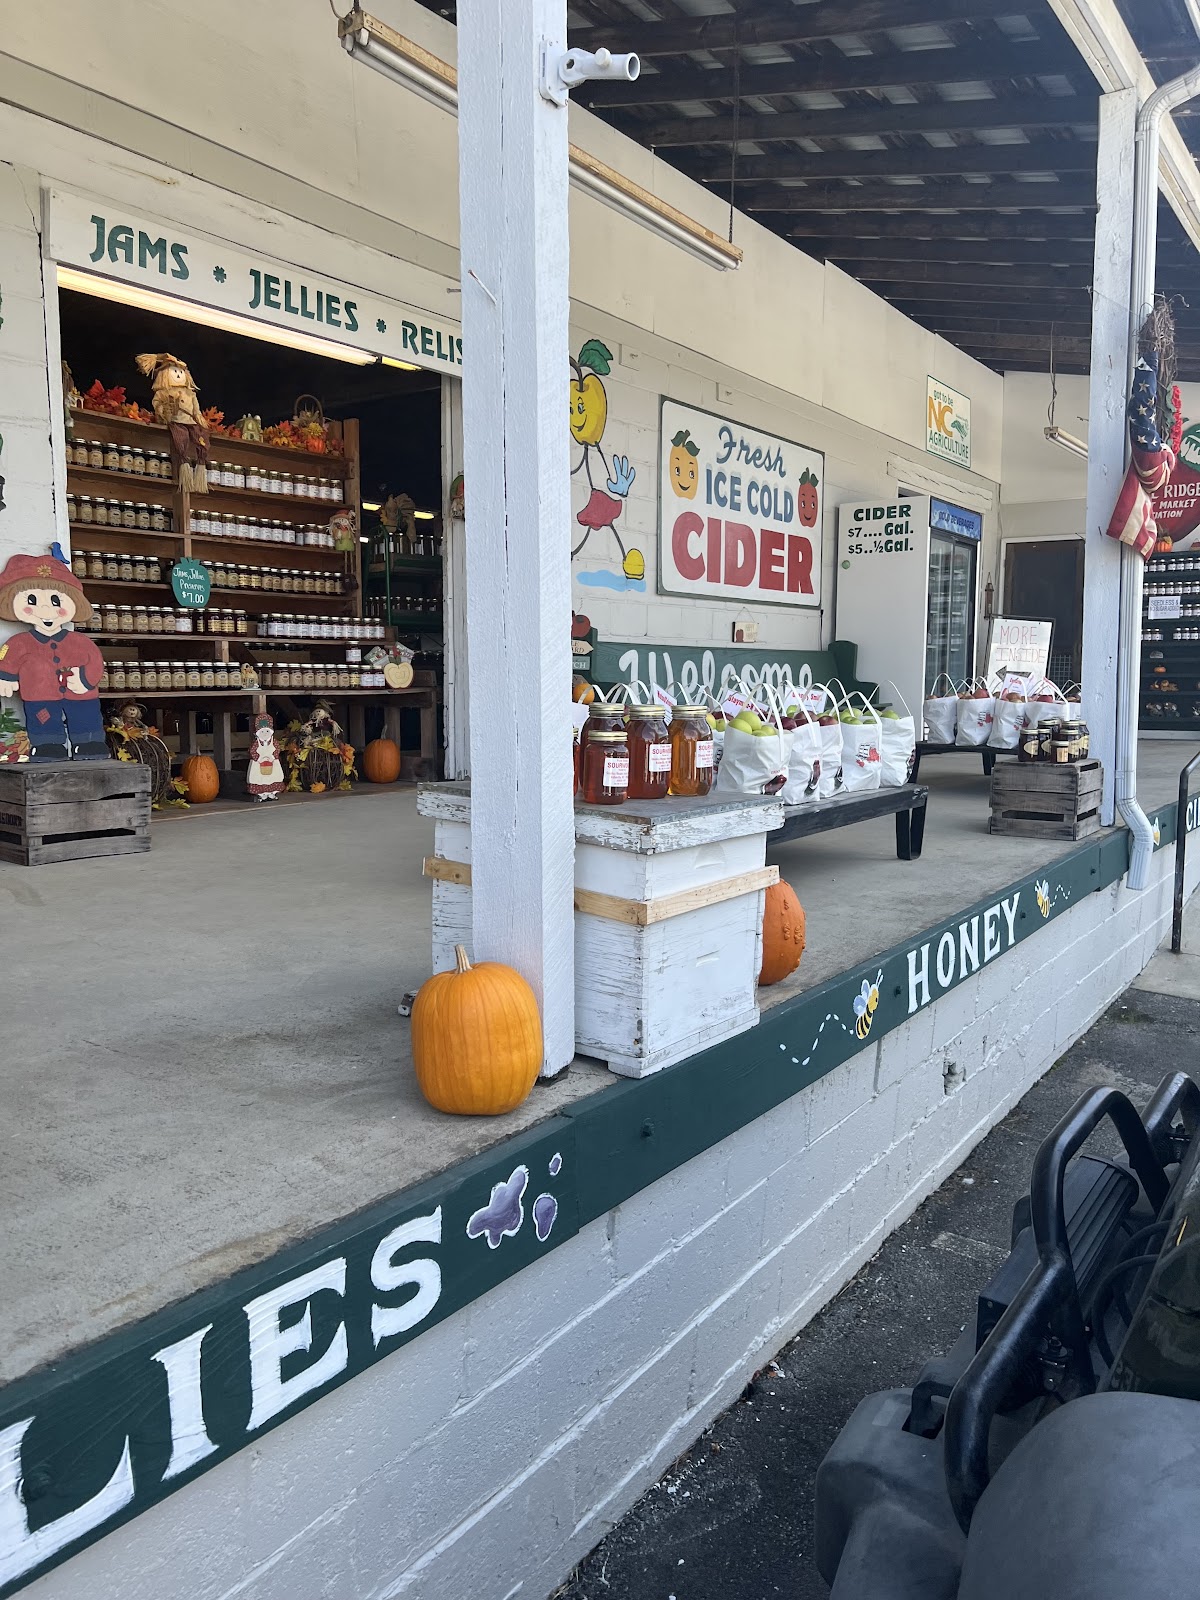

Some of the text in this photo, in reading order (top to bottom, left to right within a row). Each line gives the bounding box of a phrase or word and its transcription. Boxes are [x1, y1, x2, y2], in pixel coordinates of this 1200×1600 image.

[89, 214, 190, 282] JAMS
[248, 268, 359, 333] JELLIES
[933, 389, 954, 407] got to be
[928, 395, 953, 438] NC
[715, 425, 787, 479] Fresh
[928, 429, 969, 459] AGRICULTURE
[705, 467, 794, 524] ICE COLD
[1159, 498, 1197, 509] MARKET
[1163, 482, 1200, 499] RIDGE
[853, 504, 912, 522] CIDER
[1152, 509, 1184, 519] IATION
[671, 510, 815, 595] CIDER
[181, 590, 205, 604] $7.00
[999, 625, 1038, 645] MORE
[995, 647, 1047, 664] INSIDE
[618, 649, 813, 705] Welcome
[906, 891, 1021, 1014] HONEY
[0, 1204, 443, 1586] LIES
